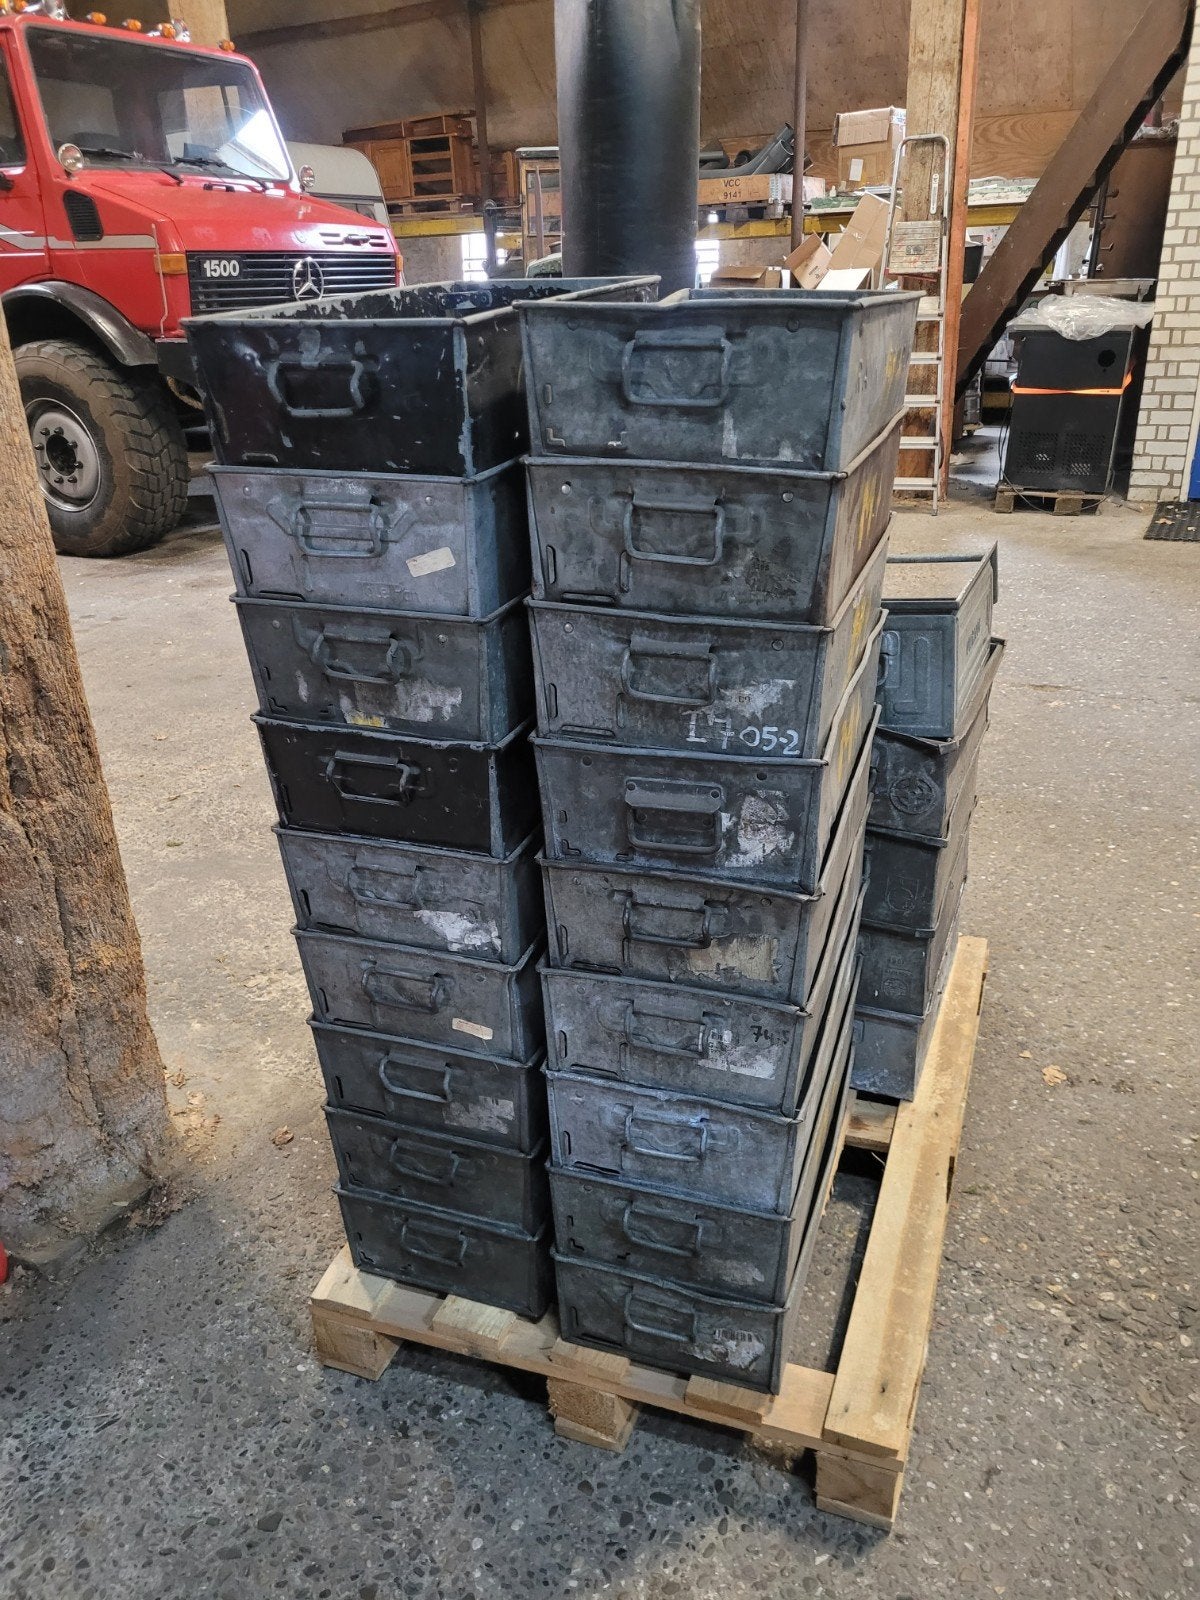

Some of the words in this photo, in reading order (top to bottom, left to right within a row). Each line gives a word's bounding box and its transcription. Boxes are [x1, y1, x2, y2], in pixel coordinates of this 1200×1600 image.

[723, 179, 741, 188] VCC
[723, 191, 742, 200] 9141
[203, 259, 240, 277] 1500
